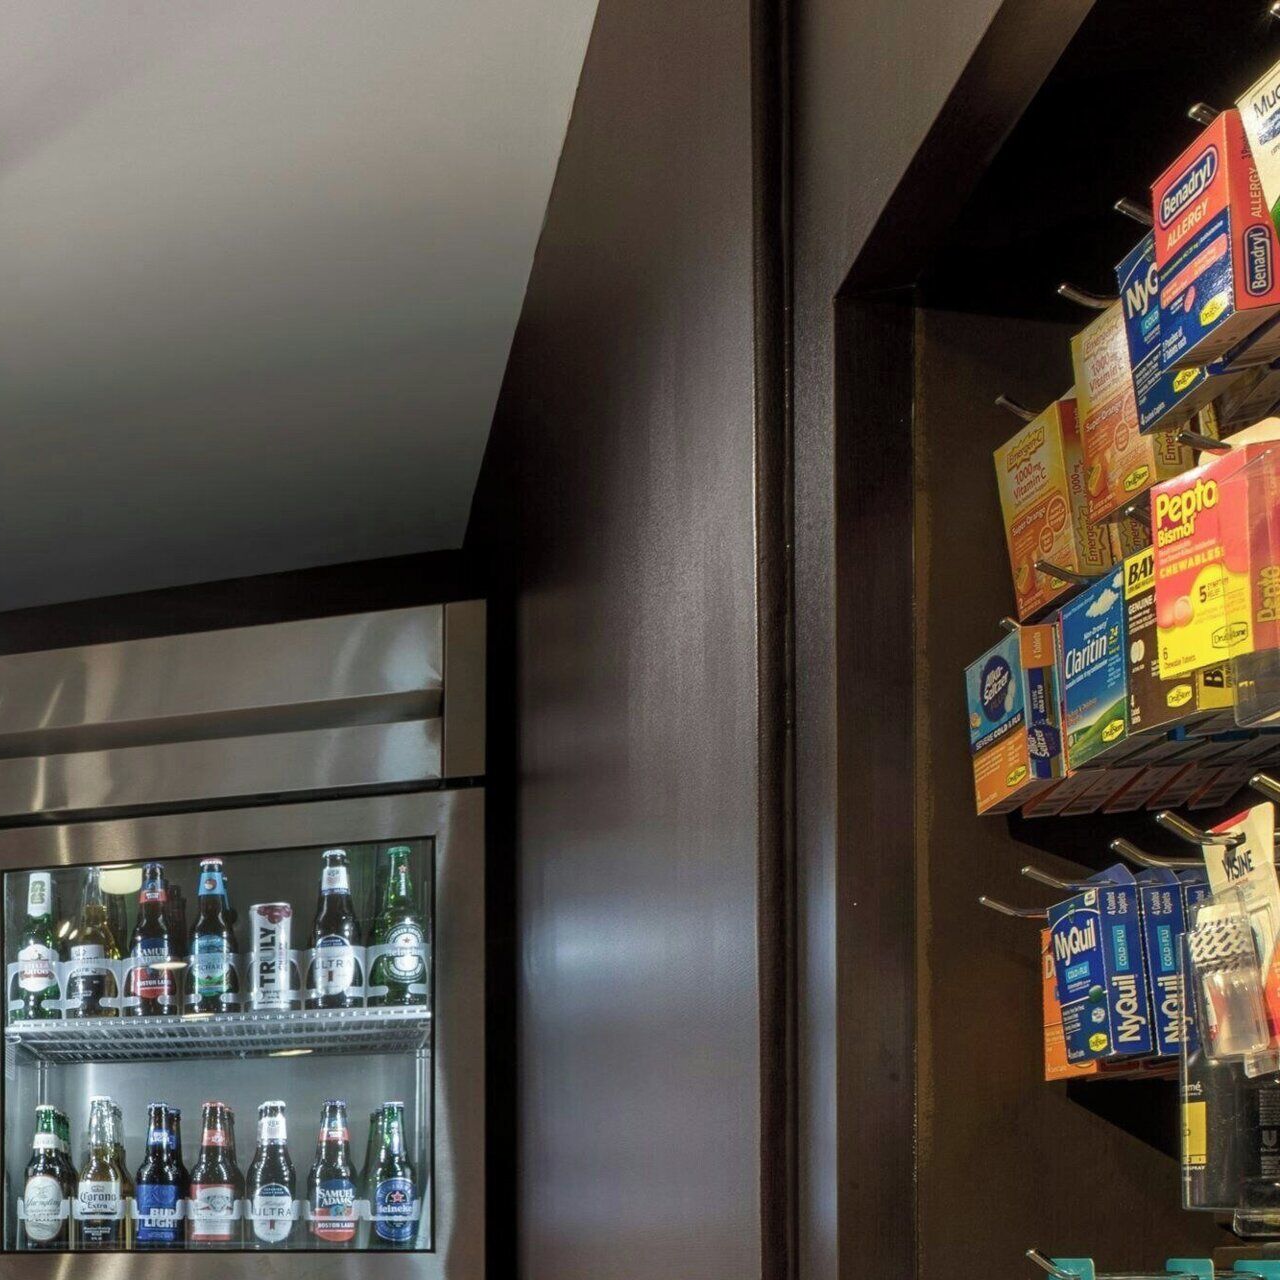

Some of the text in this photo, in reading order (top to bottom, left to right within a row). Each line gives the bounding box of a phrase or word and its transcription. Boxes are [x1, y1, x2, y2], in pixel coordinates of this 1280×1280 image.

[1163, 155, 1211, 220] Benadryl
[1249, 167, 1262, 218] ALLERGY
[1167, 198, 1209, 250] ALLERGY
[1252, 231, 1267, 289] Benadryl
[1126, 263, 1159, 319] NyQ
[1156, 478, 1218, 529] Pepto
[1157, 515, 1197, 546] Bismol
[1128, 555, 1154, 586] BAY
[1199, 586, 1208, 603] 5
[1065, 633, 1107, 680] Claritin
[1163, 648, 1169, 659] 6
[1220, 849, 1254, 883] VISINE
[260, 927, 276, 988] TRULY
[1054, 918, 1096, 967] NyQuil
[1117, 929, 1127, 967] COLD FLU
[1162, 929, 1172, 967] COLD FLU
[1111, 974, 1146, 1043] NyQuil
[150, 1207, 175, 1218] BUD
[318, 1188, 354, 1199] SAMUEL
